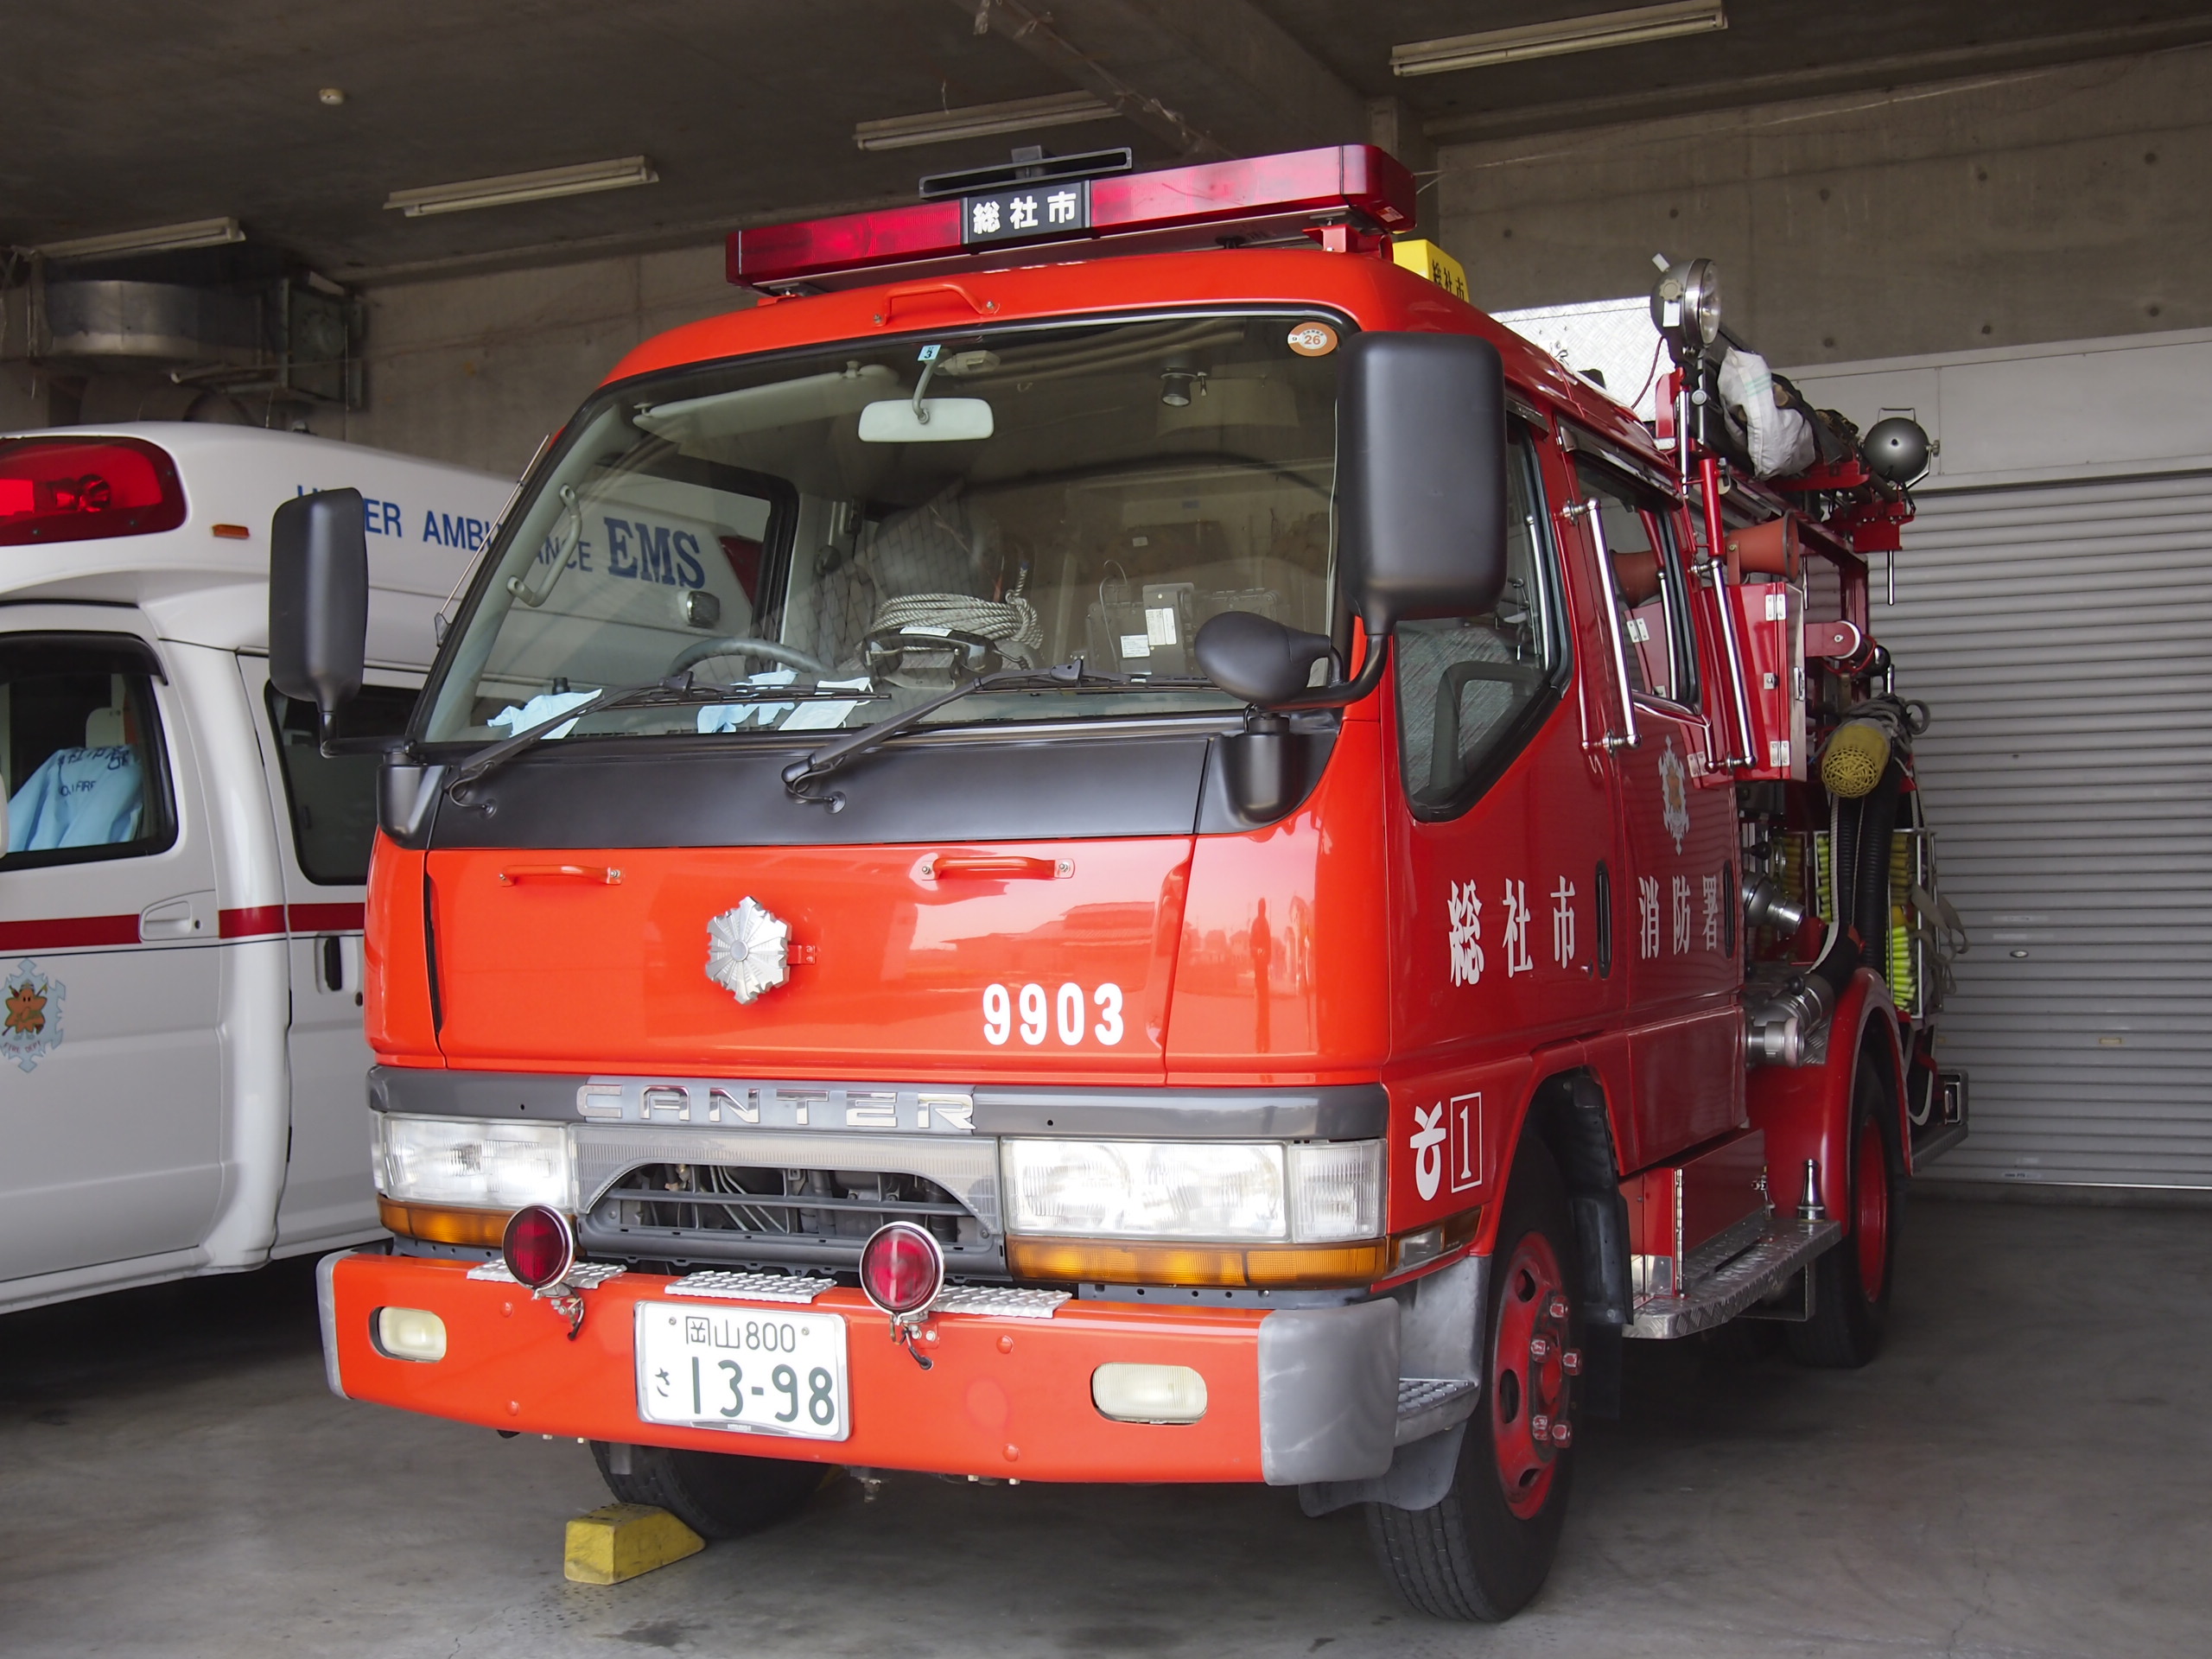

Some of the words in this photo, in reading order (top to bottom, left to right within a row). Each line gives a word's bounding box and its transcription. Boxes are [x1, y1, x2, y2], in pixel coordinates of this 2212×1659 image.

[973, 191, 1077, 234] 総社市
[1304, 335, 1321, 345] 26
[423, 510, 593, 572] AMBUNE
[603, 516, 705, 589] EMS
[1447, 874, 1576, 988] 総社市
[1638, 874, 1718, 960] 消防署
[982, 982, 1124, 1046] 9903
[576, 1084, 976, 1130] CANTER
[654, 1368, 671, 1397] さ
[692, 1357, 836, 1426] 13-98
